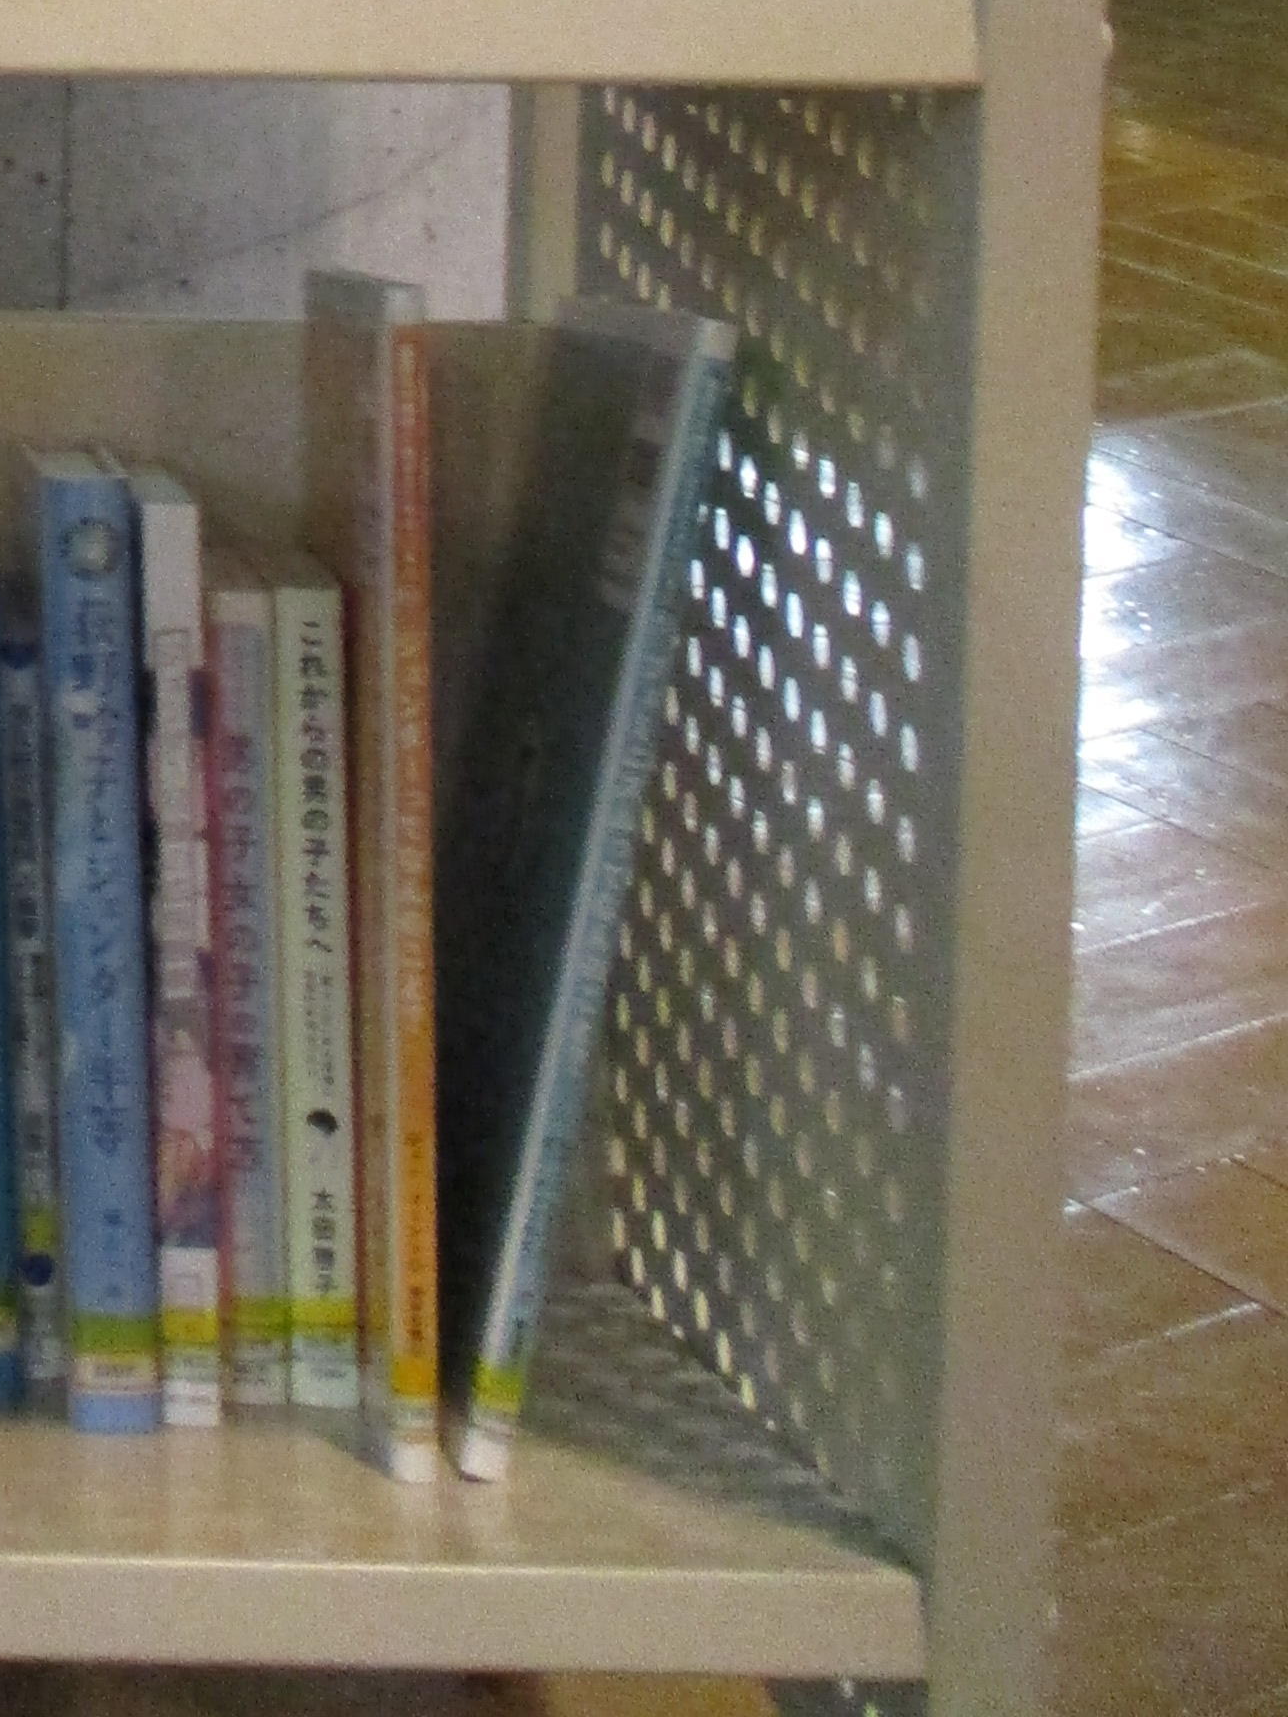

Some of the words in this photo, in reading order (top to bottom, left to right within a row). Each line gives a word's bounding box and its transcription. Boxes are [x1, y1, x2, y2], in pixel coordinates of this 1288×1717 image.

[295, 613, 333, 960] これからの男の子たちへ
